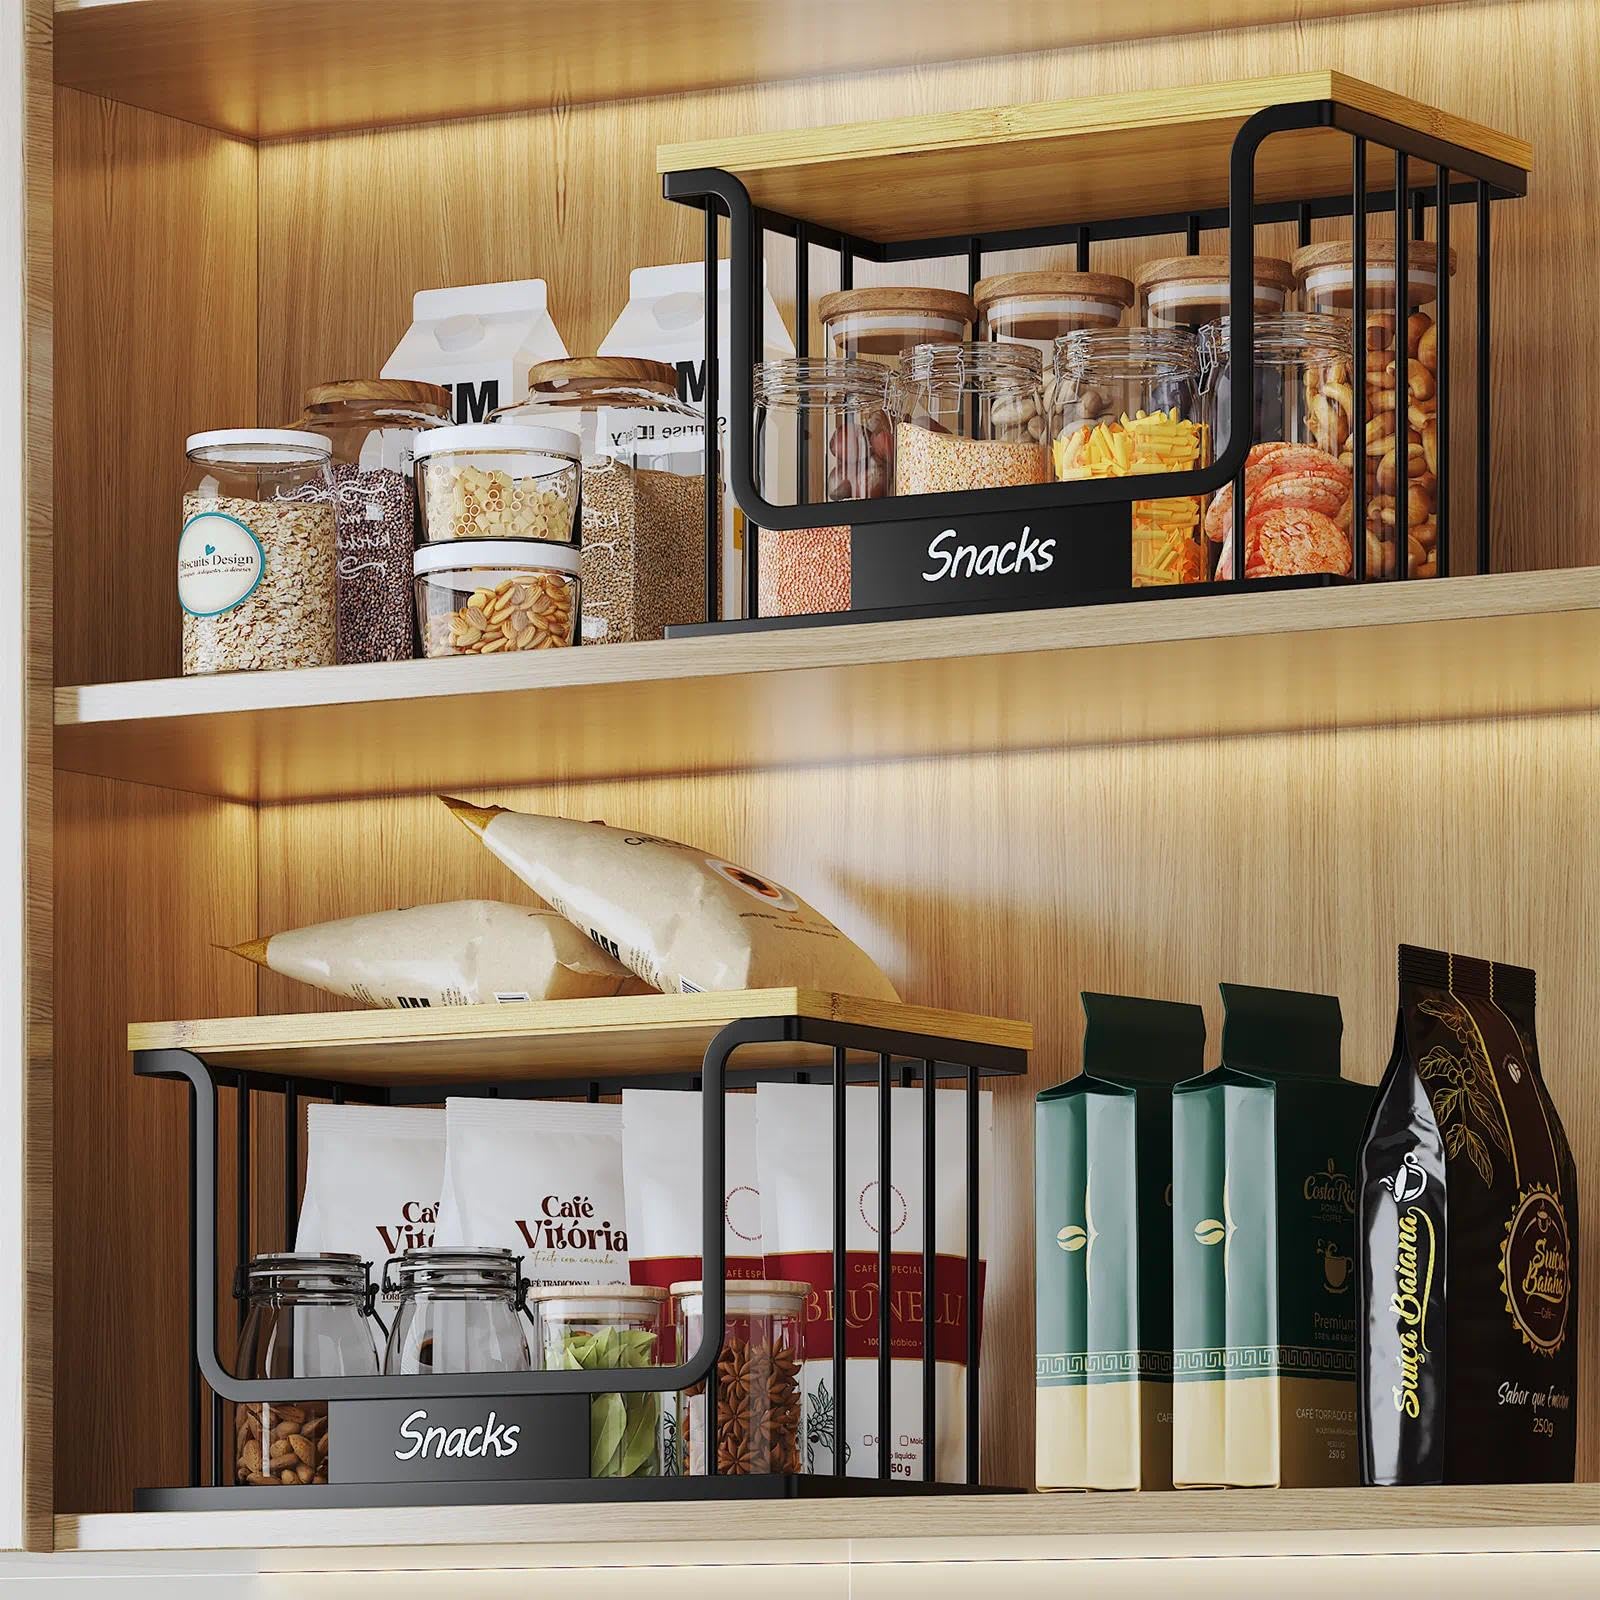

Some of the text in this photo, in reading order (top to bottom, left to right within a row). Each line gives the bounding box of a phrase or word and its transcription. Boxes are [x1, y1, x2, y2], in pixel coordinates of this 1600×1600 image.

[212, 553, 254, 567] Design
[922, 525, 1057, 582] Snacks
[541, 1195, 594, 1218] Café
[515, 1219, 628, 1252] Vitória
[1498, 1381, 1530, 1406] Sabor
[1532, 1392, 1546, 1414] que
[394, 1409, 520, 1460] Snacks
[1533, 1417, 1554, 1438] 250g
